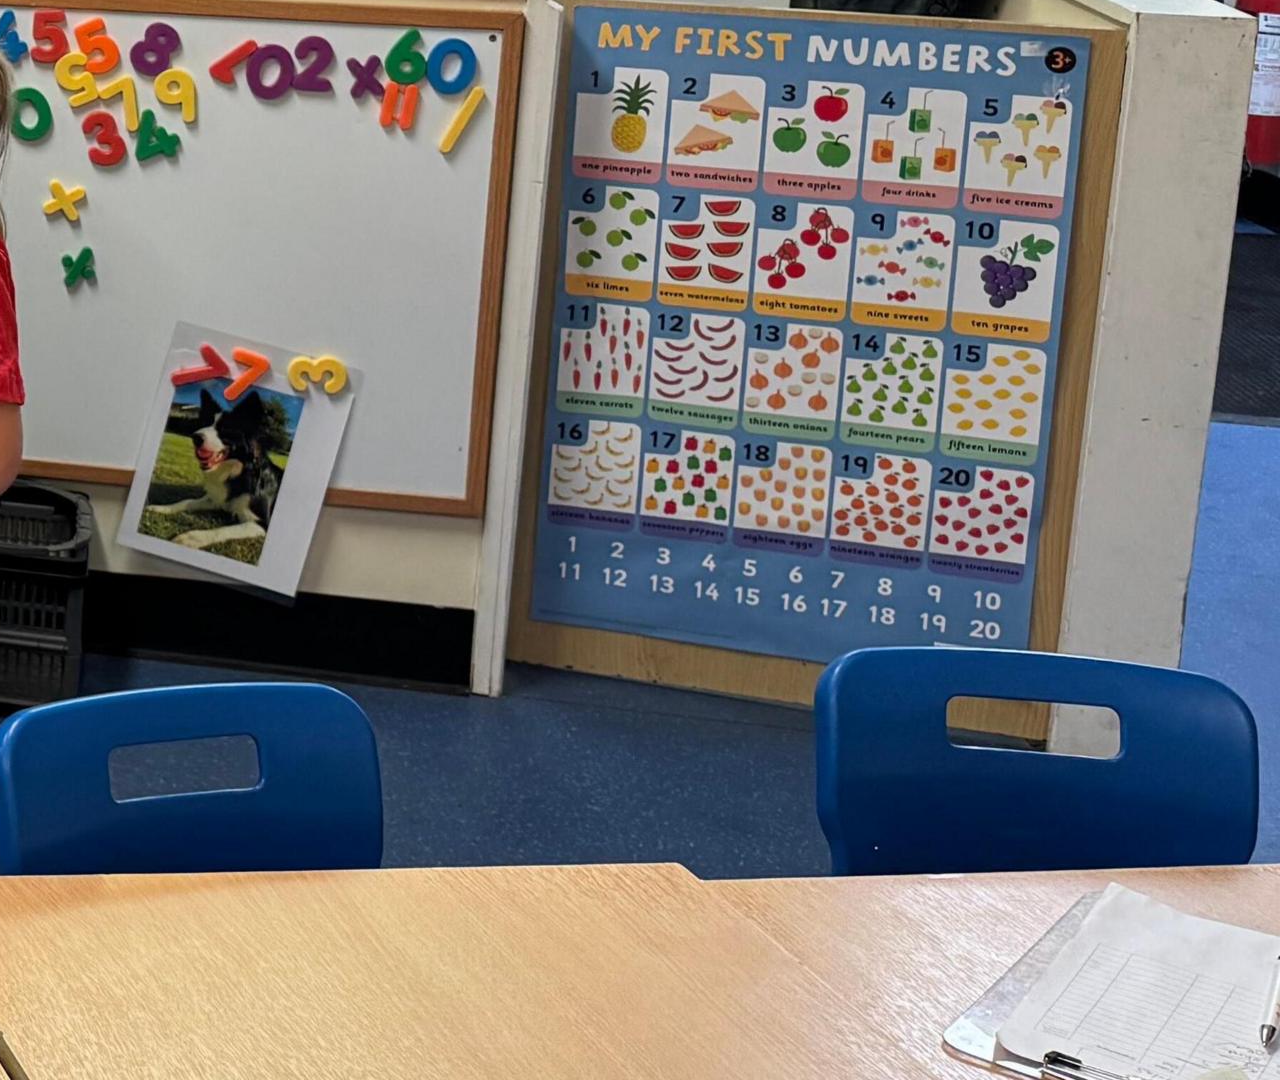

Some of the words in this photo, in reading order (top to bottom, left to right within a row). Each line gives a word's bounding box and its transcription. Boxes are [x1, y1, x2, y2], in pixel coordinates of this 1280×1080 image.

[598, 22, 661, 51] MY
[674, 27, 792, 61] FIRST
[807, 35, 1017, 77] NUMBERS
[1051, 51, 1073, 69] 3+
[591, 71, 599, 88] 1
[682, 77, 697, 95] 2
[781, 84, 796, 102] 3
[880, 91, 896, 109] 4
[983, 98, 999, 117] 5
[581, 162, 600, 171] one
[602, 163, 652, 176] pineapple
[671, 170, 690, 178] two
[693, 170, 753, 184] sandwiches
[777, 178, 803, 188] three
[806, 180, 842, 191] apples
[881, 186, 903, 198] four
[905, 188, 937, 199] drinks
[970, 193, 992, 205] five
[995, 196, 1012, 205] ice
[1014, 200, 1054, 210] creams
[582, 187, 596, 205] 6
[671, 195, 686, 213] 7
[771, 204, 787, 222] 8
[871, 213, 885, 232] 9
[965, 221, 994, 240] 10
[585, 280, 600, 290] six
[603, 281, 630, 293] limes
[659, 289, 684, 298] seven
[687, 291, 745, 305] watermelons
[759, 298, 786, 310] eight
[788, 301, 839, 314] tomatoes
[867, 309, 890, 319] nine
[893, 312, 929, 322] sweets
[567, 304, 590, 322] 11
[658, 314, 683, 332] 12
[754, 323, 780, 342] 13
[852, 333, 880, 353] 14
[953, 343, 981, 363] 15
[971, 319, 989, 329] ten
[992, 321, 1029, 333] grapes
[565, 396, 597, 406] eleven
[599, 399, 633, 409] carrots
[652, 404, 684, 416] twelve
[687, 410, 734, 424] sausages
[748, 417, 790, 429] thirteen
[792, 422, 828, 433] onions
[848, 428, 893, 441] fourteen
[896, 434, 926, 445] pears
[557, 423, 582, 440] 16
[649, 431, 676, 449] 17
[743, 443, 770, 461] 18
[841, 455, 868, 473] 19
[938, 468, 970, 487] 20
[947, 439, 985, 452] fifteen
[988, 444, 1027, 457] lemons
[742, 532, 786, 546] eighteen
[789, 540, 813, 549] eggs
[831, 545, 875, 558] nineteen
[568, 536, 576, 552] 1
[611, 542, 625, 559] 2
[656, 548, 671, 565] 3
[701, 554, 716, 572] 4
[743, 559, 757, 577] 5
[789, 566, 803, 583] 6
[830, 571, 845, 589] 7
[877, 578, 893, 596] 8
[927, 585, 941, 603] 9
[973, 591, 1001, 610] 10
[559, 562, 580, 580] 11
[603, 568, 627, 587] 12
[650, 575, 674, 594] 13
[694, 582, 719, 601] 14
[734, 586, 760, 606] 15
[781, 593, 807, 613] 16
[821, 598, 848, 618] 17
[869, 606, 896, 624] 18
[920, 613, 946, 633] 19
[969, 620, 1001, 640] 20
